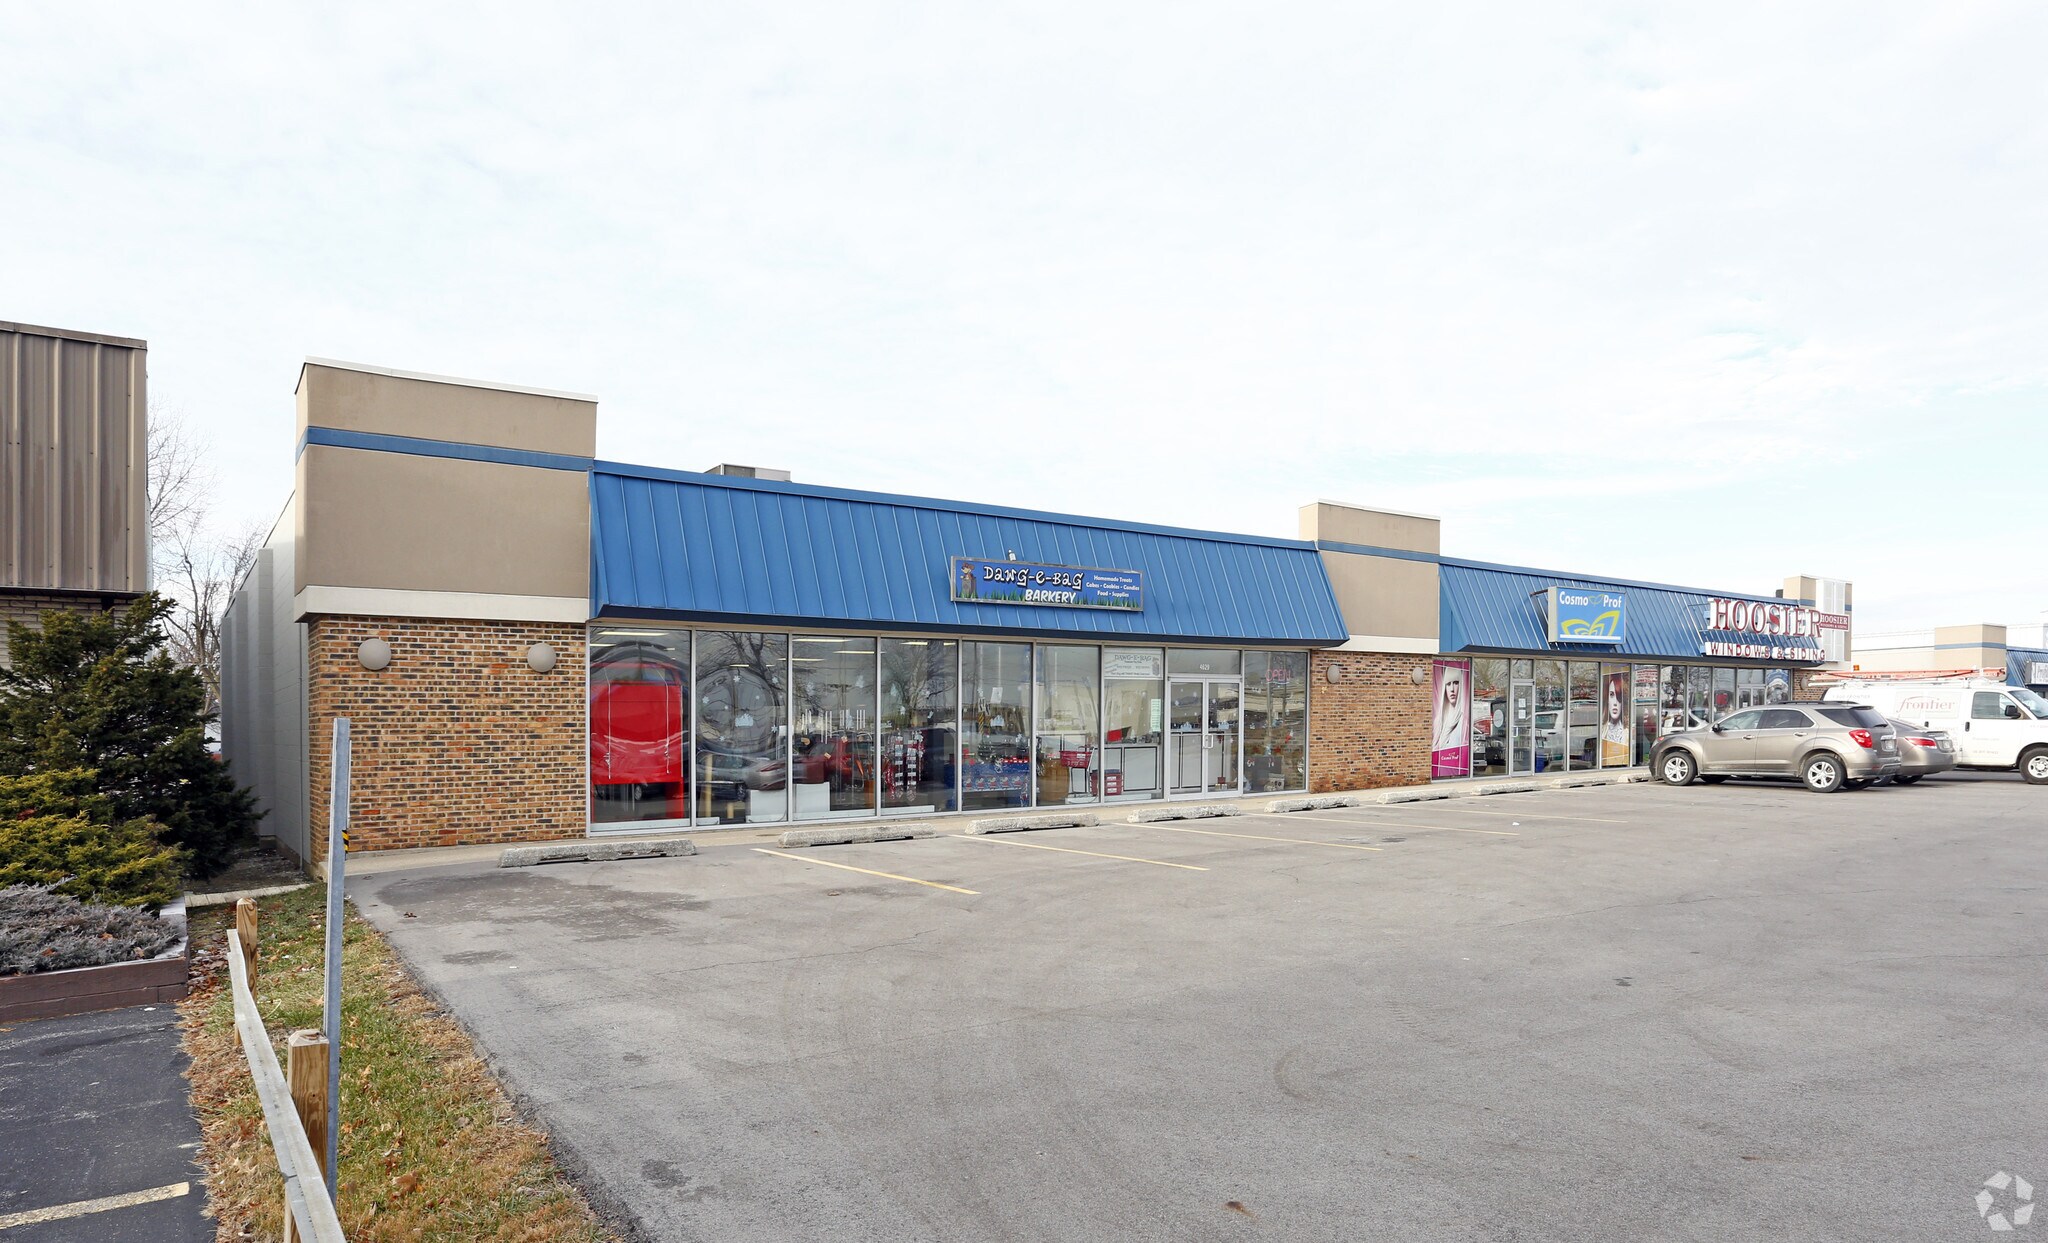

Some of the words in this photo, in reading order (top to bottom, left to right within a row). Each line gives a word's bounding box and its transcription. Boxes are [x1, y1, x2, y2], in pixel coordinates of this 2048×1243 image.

[1025, 589, 1077, 604] BARKERY
[1559, 591, 1589, 606] Cosmo
[1603, 594, 1622, 608] Prof
[1709, 598, 1822, 638] HOOSIER
[1820, 615, 1848, 625] HOOSIER
[1709, 642, 1771, 659] WINDOWS
[1776, 647, 1785, 659] &
[1789, 647, 1825, 661] SIDING
[1265, 669, 1291, 682] OPEN
